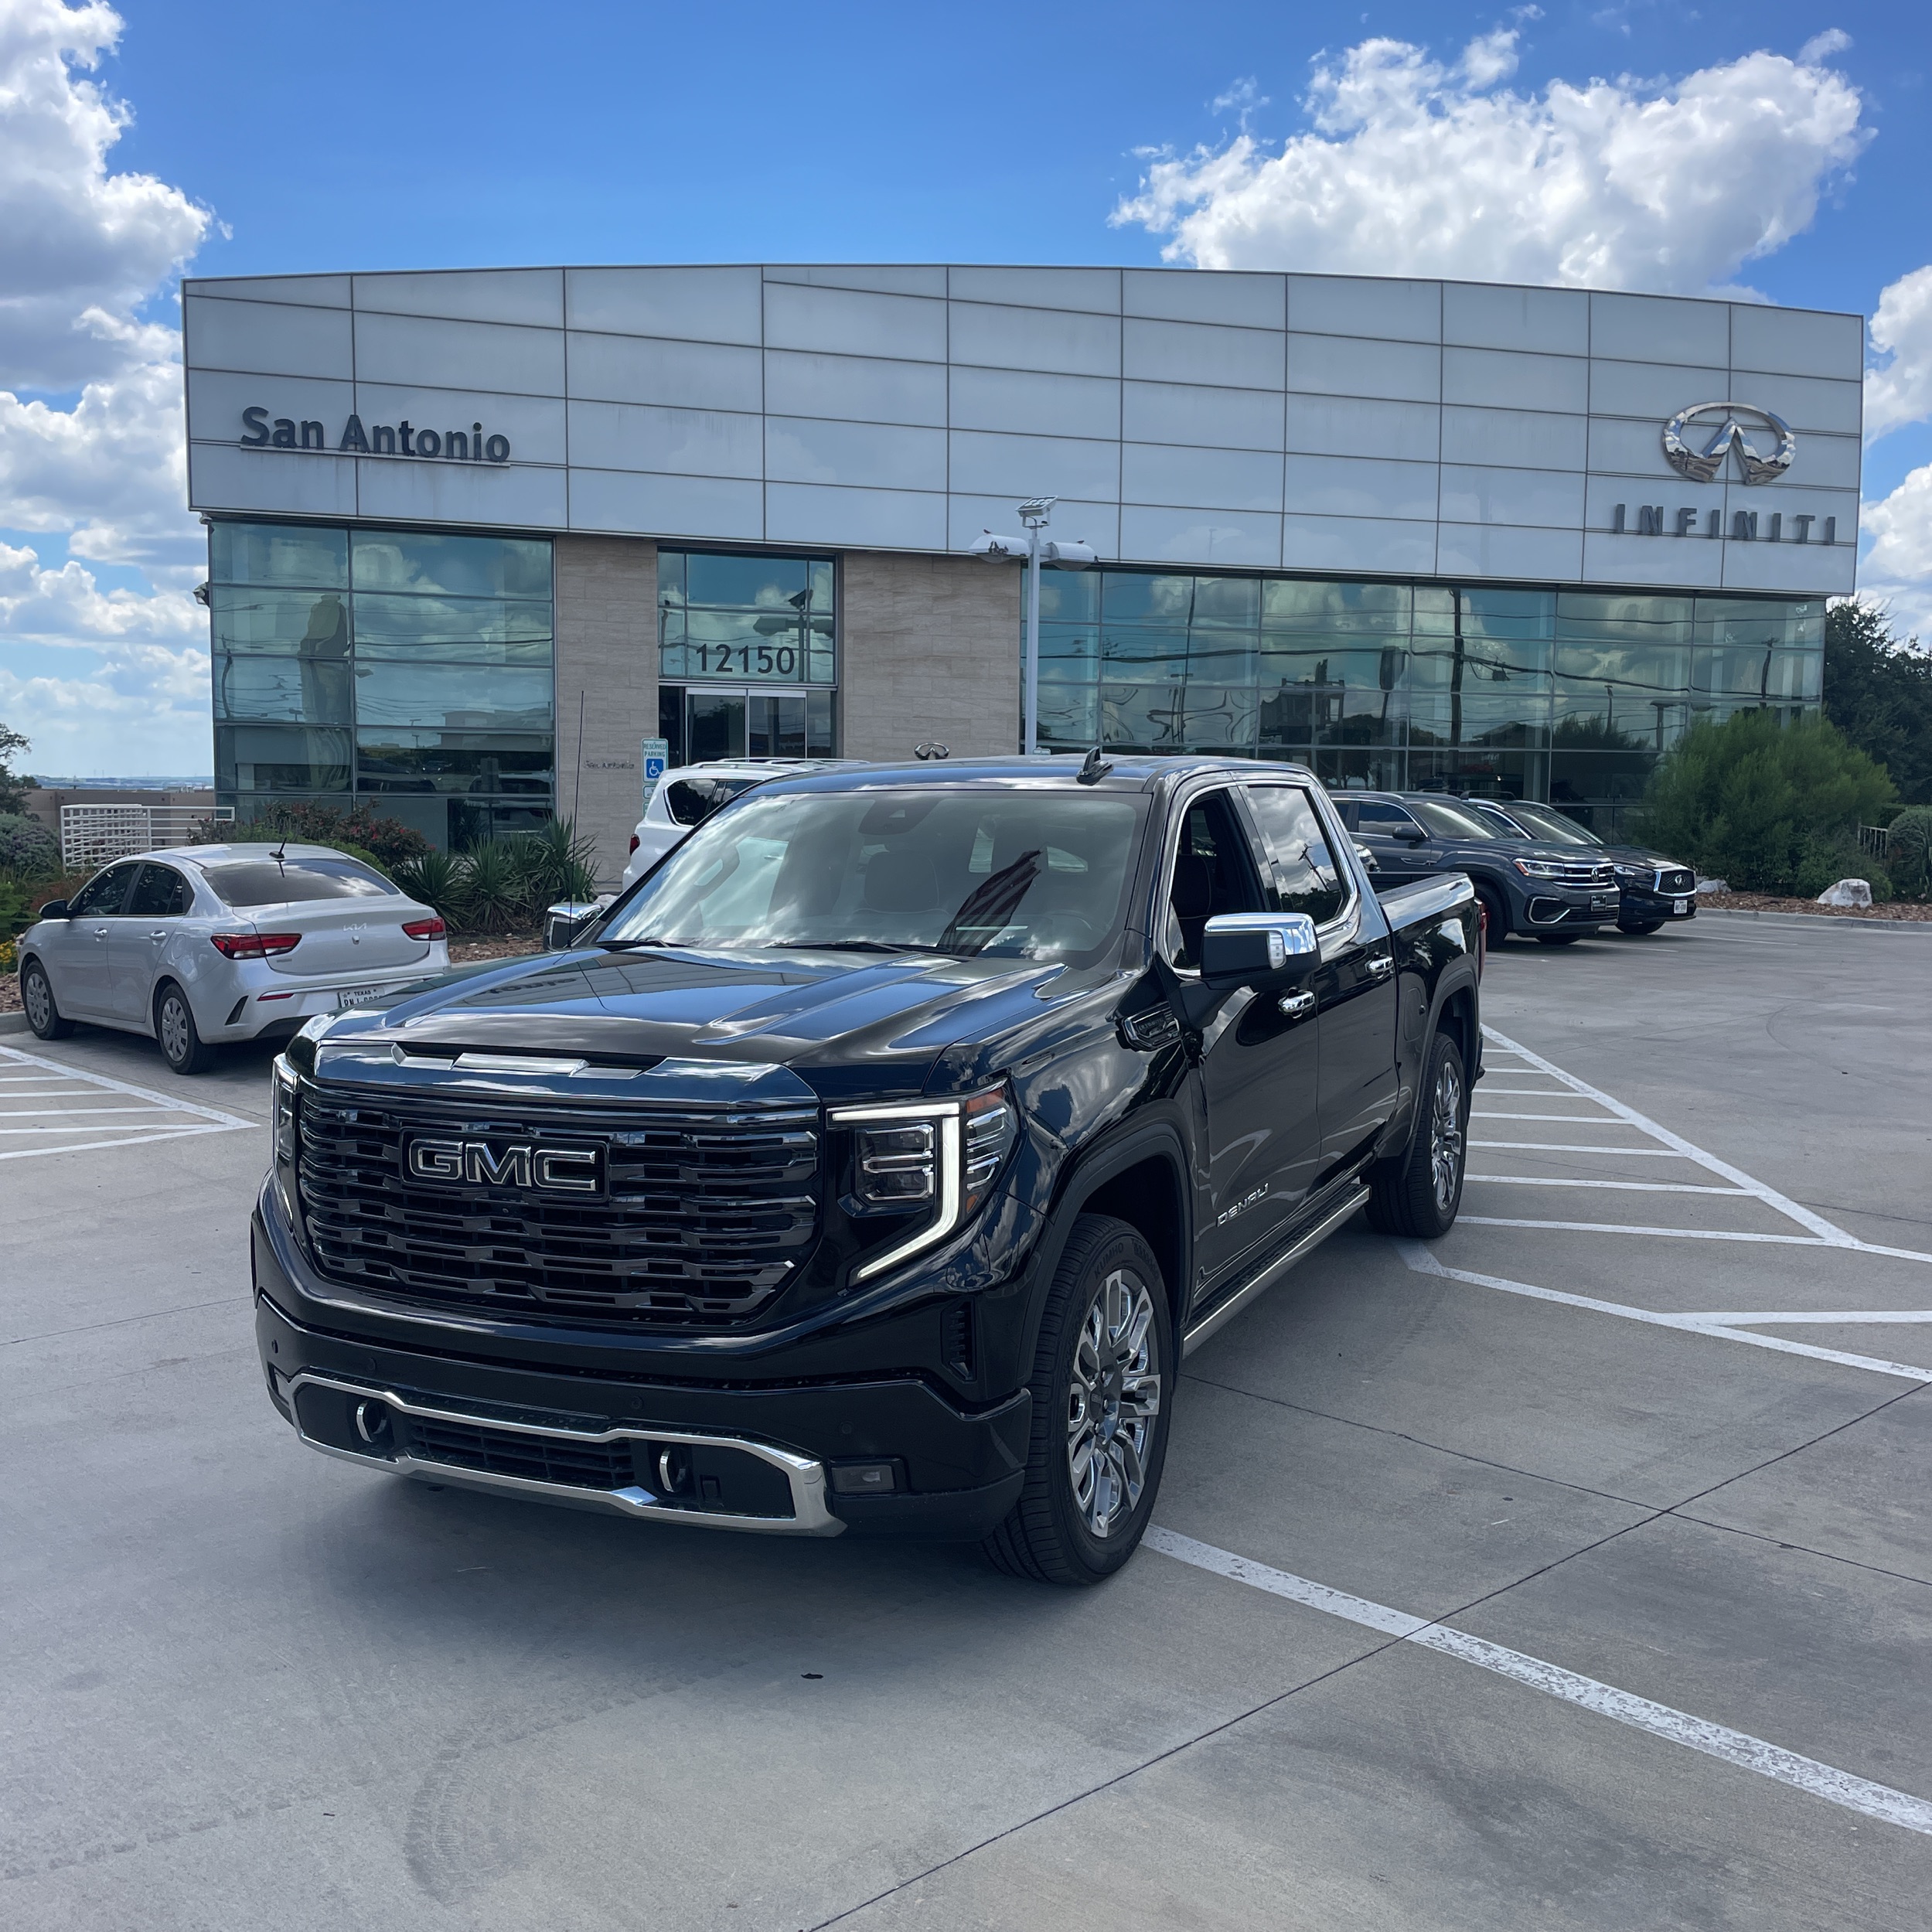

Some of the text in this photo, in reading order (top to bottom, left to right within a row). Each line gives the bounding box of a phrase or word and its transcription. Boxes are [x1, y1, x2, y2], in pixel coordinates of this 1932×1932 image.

[240, 406, 511, 463] San Antonio
[1615, 503, 1836, 545] INFINITI
[696, 643, 795, 675] 12150
[408, 1138, 597, 1191] GMC
[1215, 1182, 1269, 1228] DENALI
[1094, 1242, 1124, 1279] KUMHO
